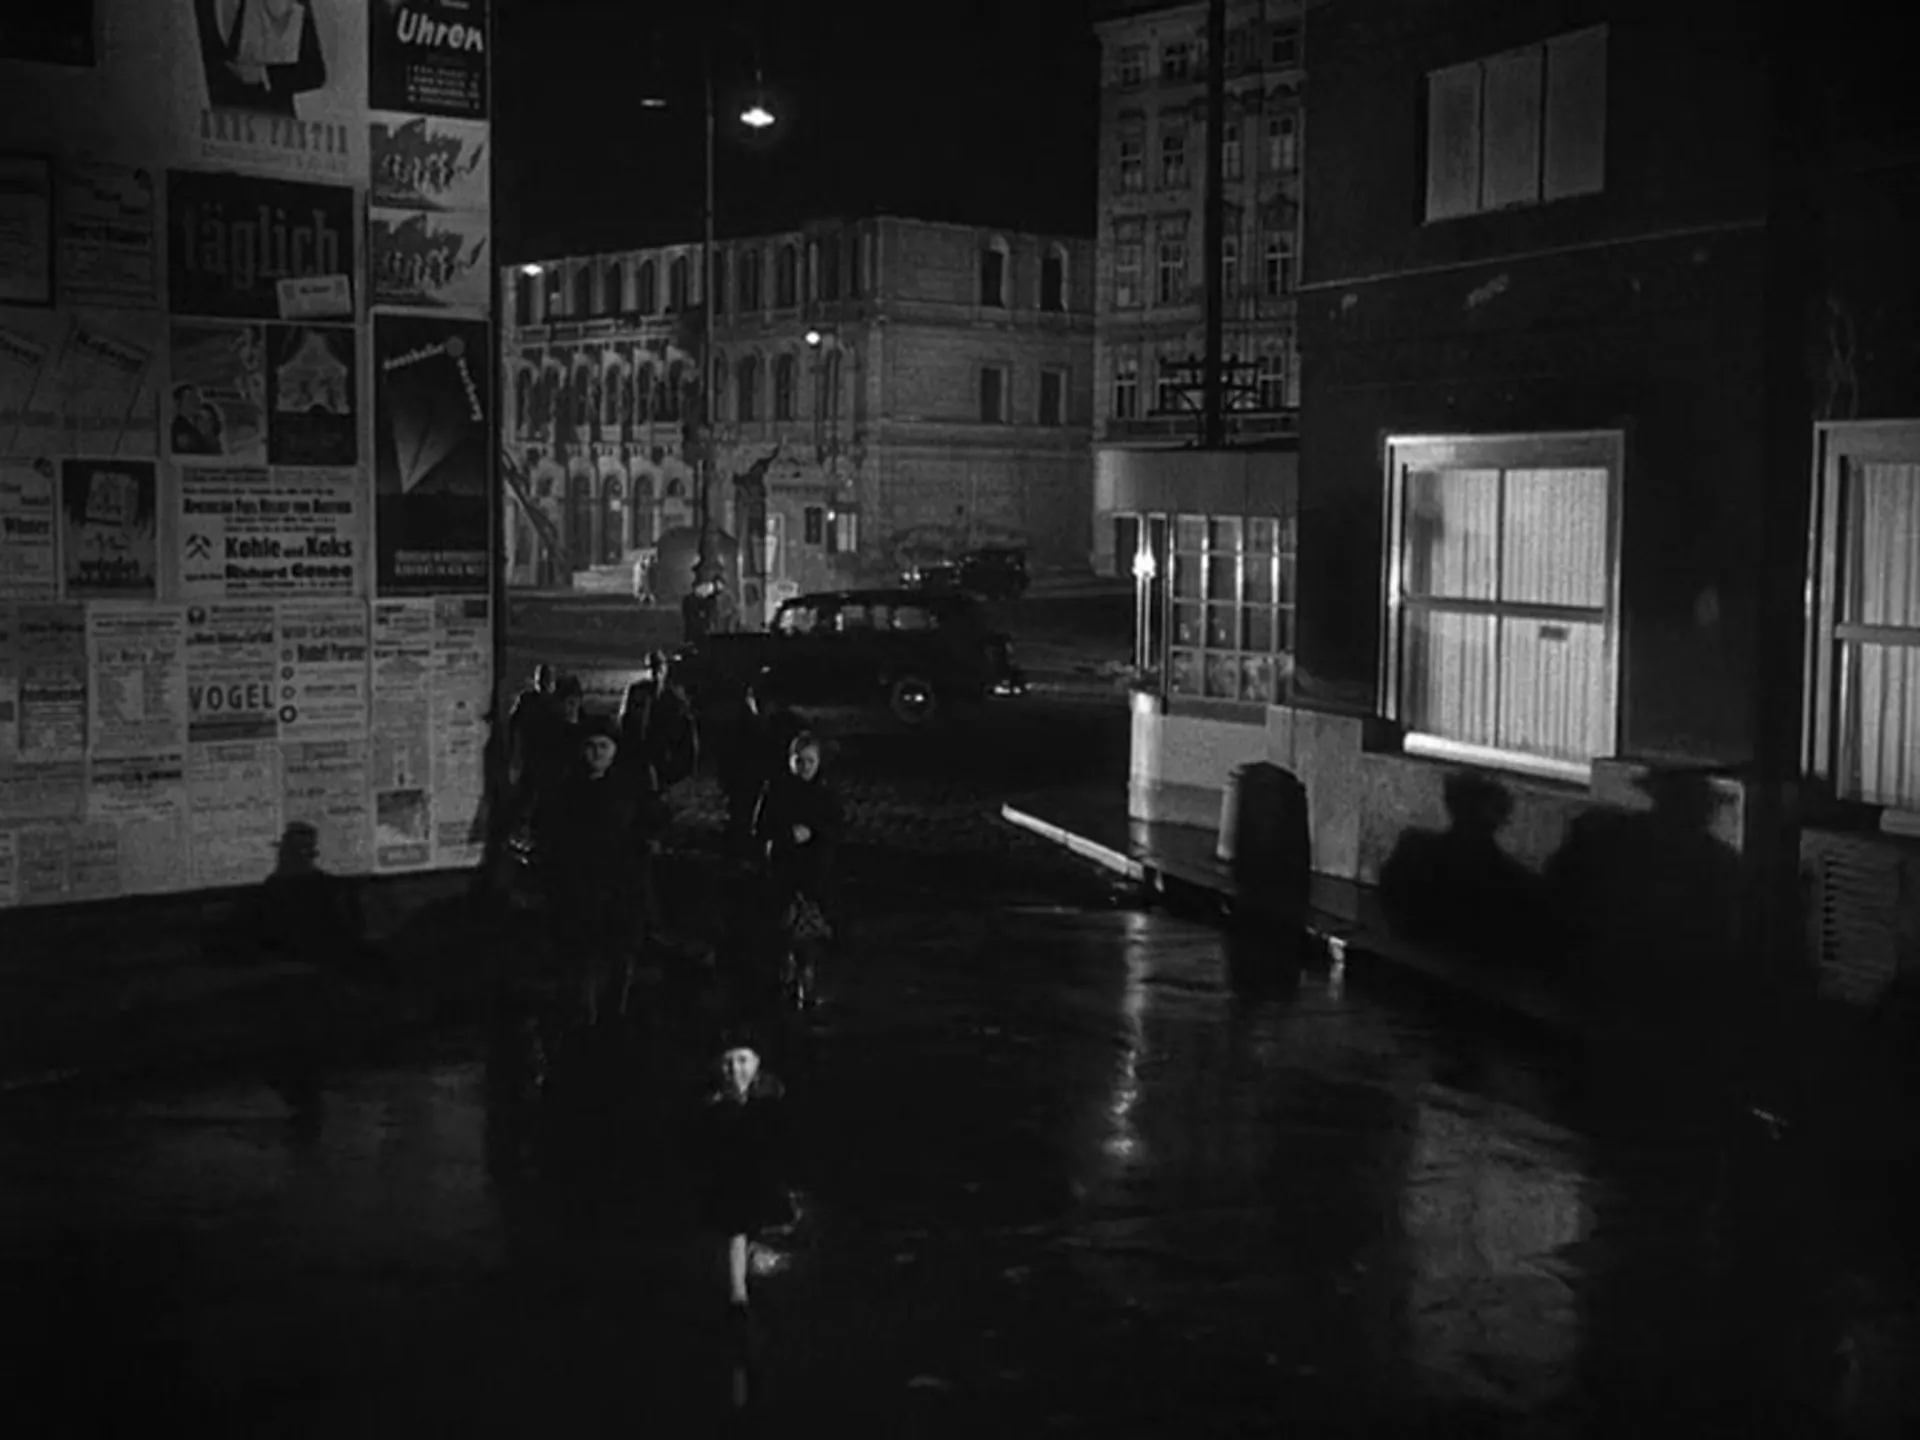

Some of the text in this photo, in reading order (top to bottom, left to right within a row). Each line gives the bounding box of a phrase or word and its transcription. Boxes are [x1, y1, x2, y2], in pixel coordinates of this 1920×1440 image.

[182, 202, 339, 291] täglich
[225, 536, 281, 559] Kohle
[305, 536, 353, 559] Koks
[188, 681, 276, 712] VOGEL
